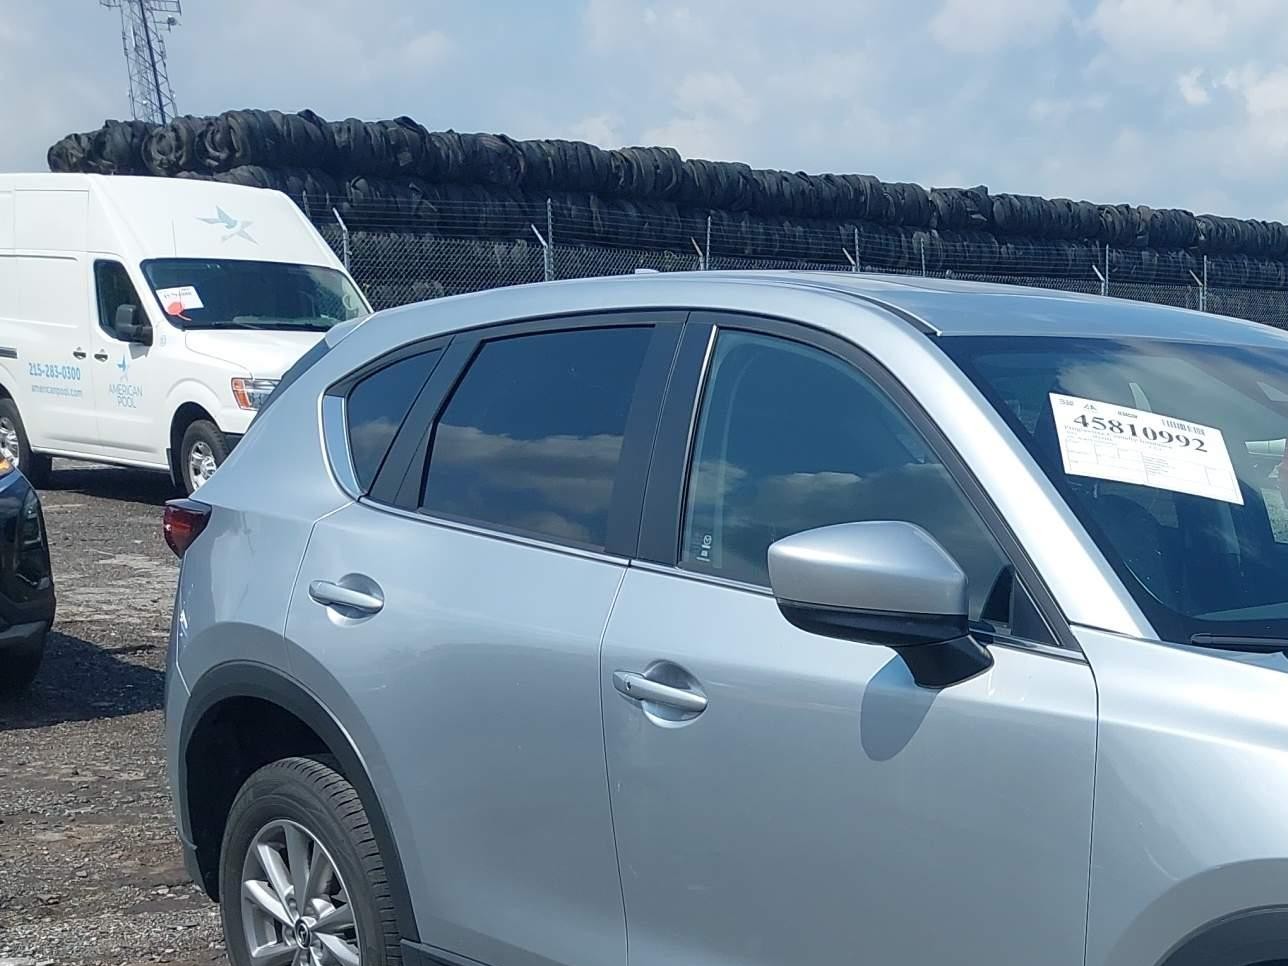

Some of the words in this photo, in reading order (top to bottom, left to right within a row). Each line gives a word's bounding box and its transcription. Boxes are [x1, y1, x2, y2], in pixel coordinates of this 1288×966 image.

[28, 362, 81, 381] 215-283-0300
[109, 383, 143, 397] AMERICAN
[117, 395, 137, 409] POOL
[1073, 413, 1208, 453] 45810992
